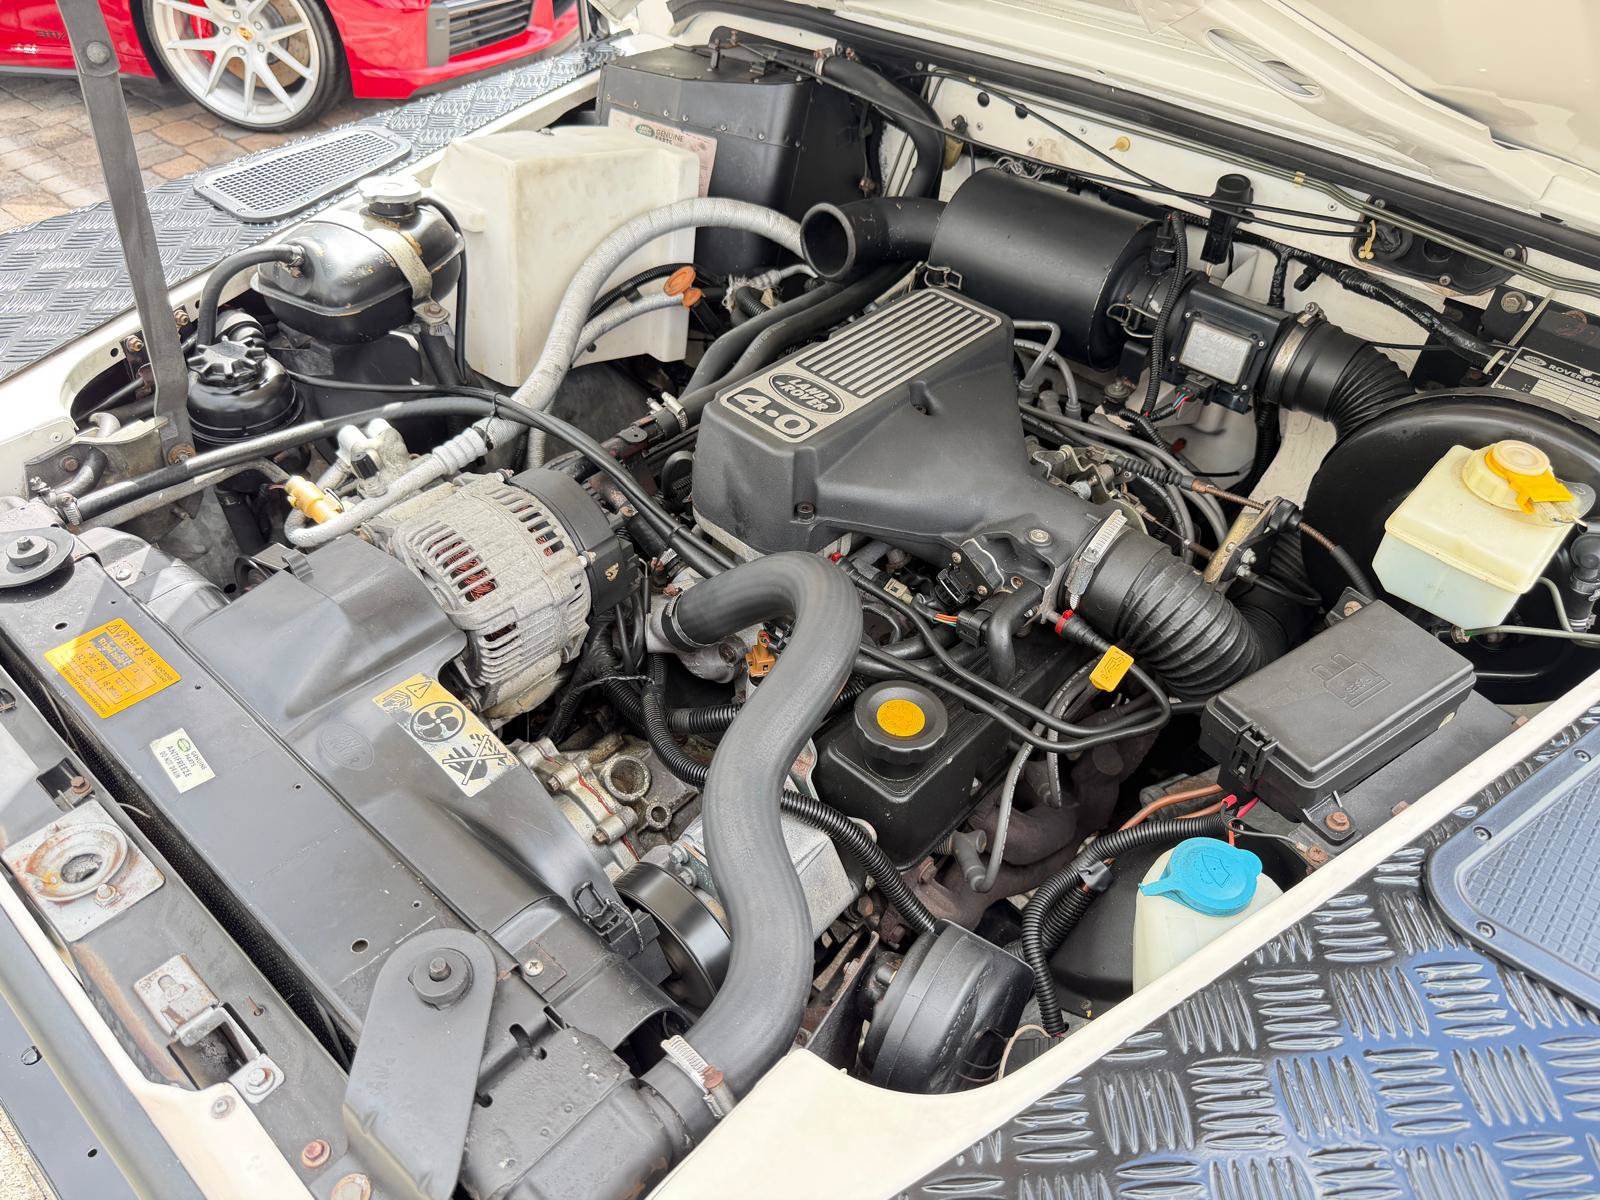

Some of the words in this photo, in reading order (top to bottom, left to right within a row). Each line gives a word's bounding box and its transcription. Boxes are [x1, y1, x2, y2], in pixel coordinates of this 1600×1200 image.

[655, 129, 684, 142] GENUINE
[1549, 364, 1584, 380] ROVER
[780, 384, 829, 410] ROVER
[788, 379, 830, 400] LAND
[167, 745, 192, 778] ANTIFREEZE
